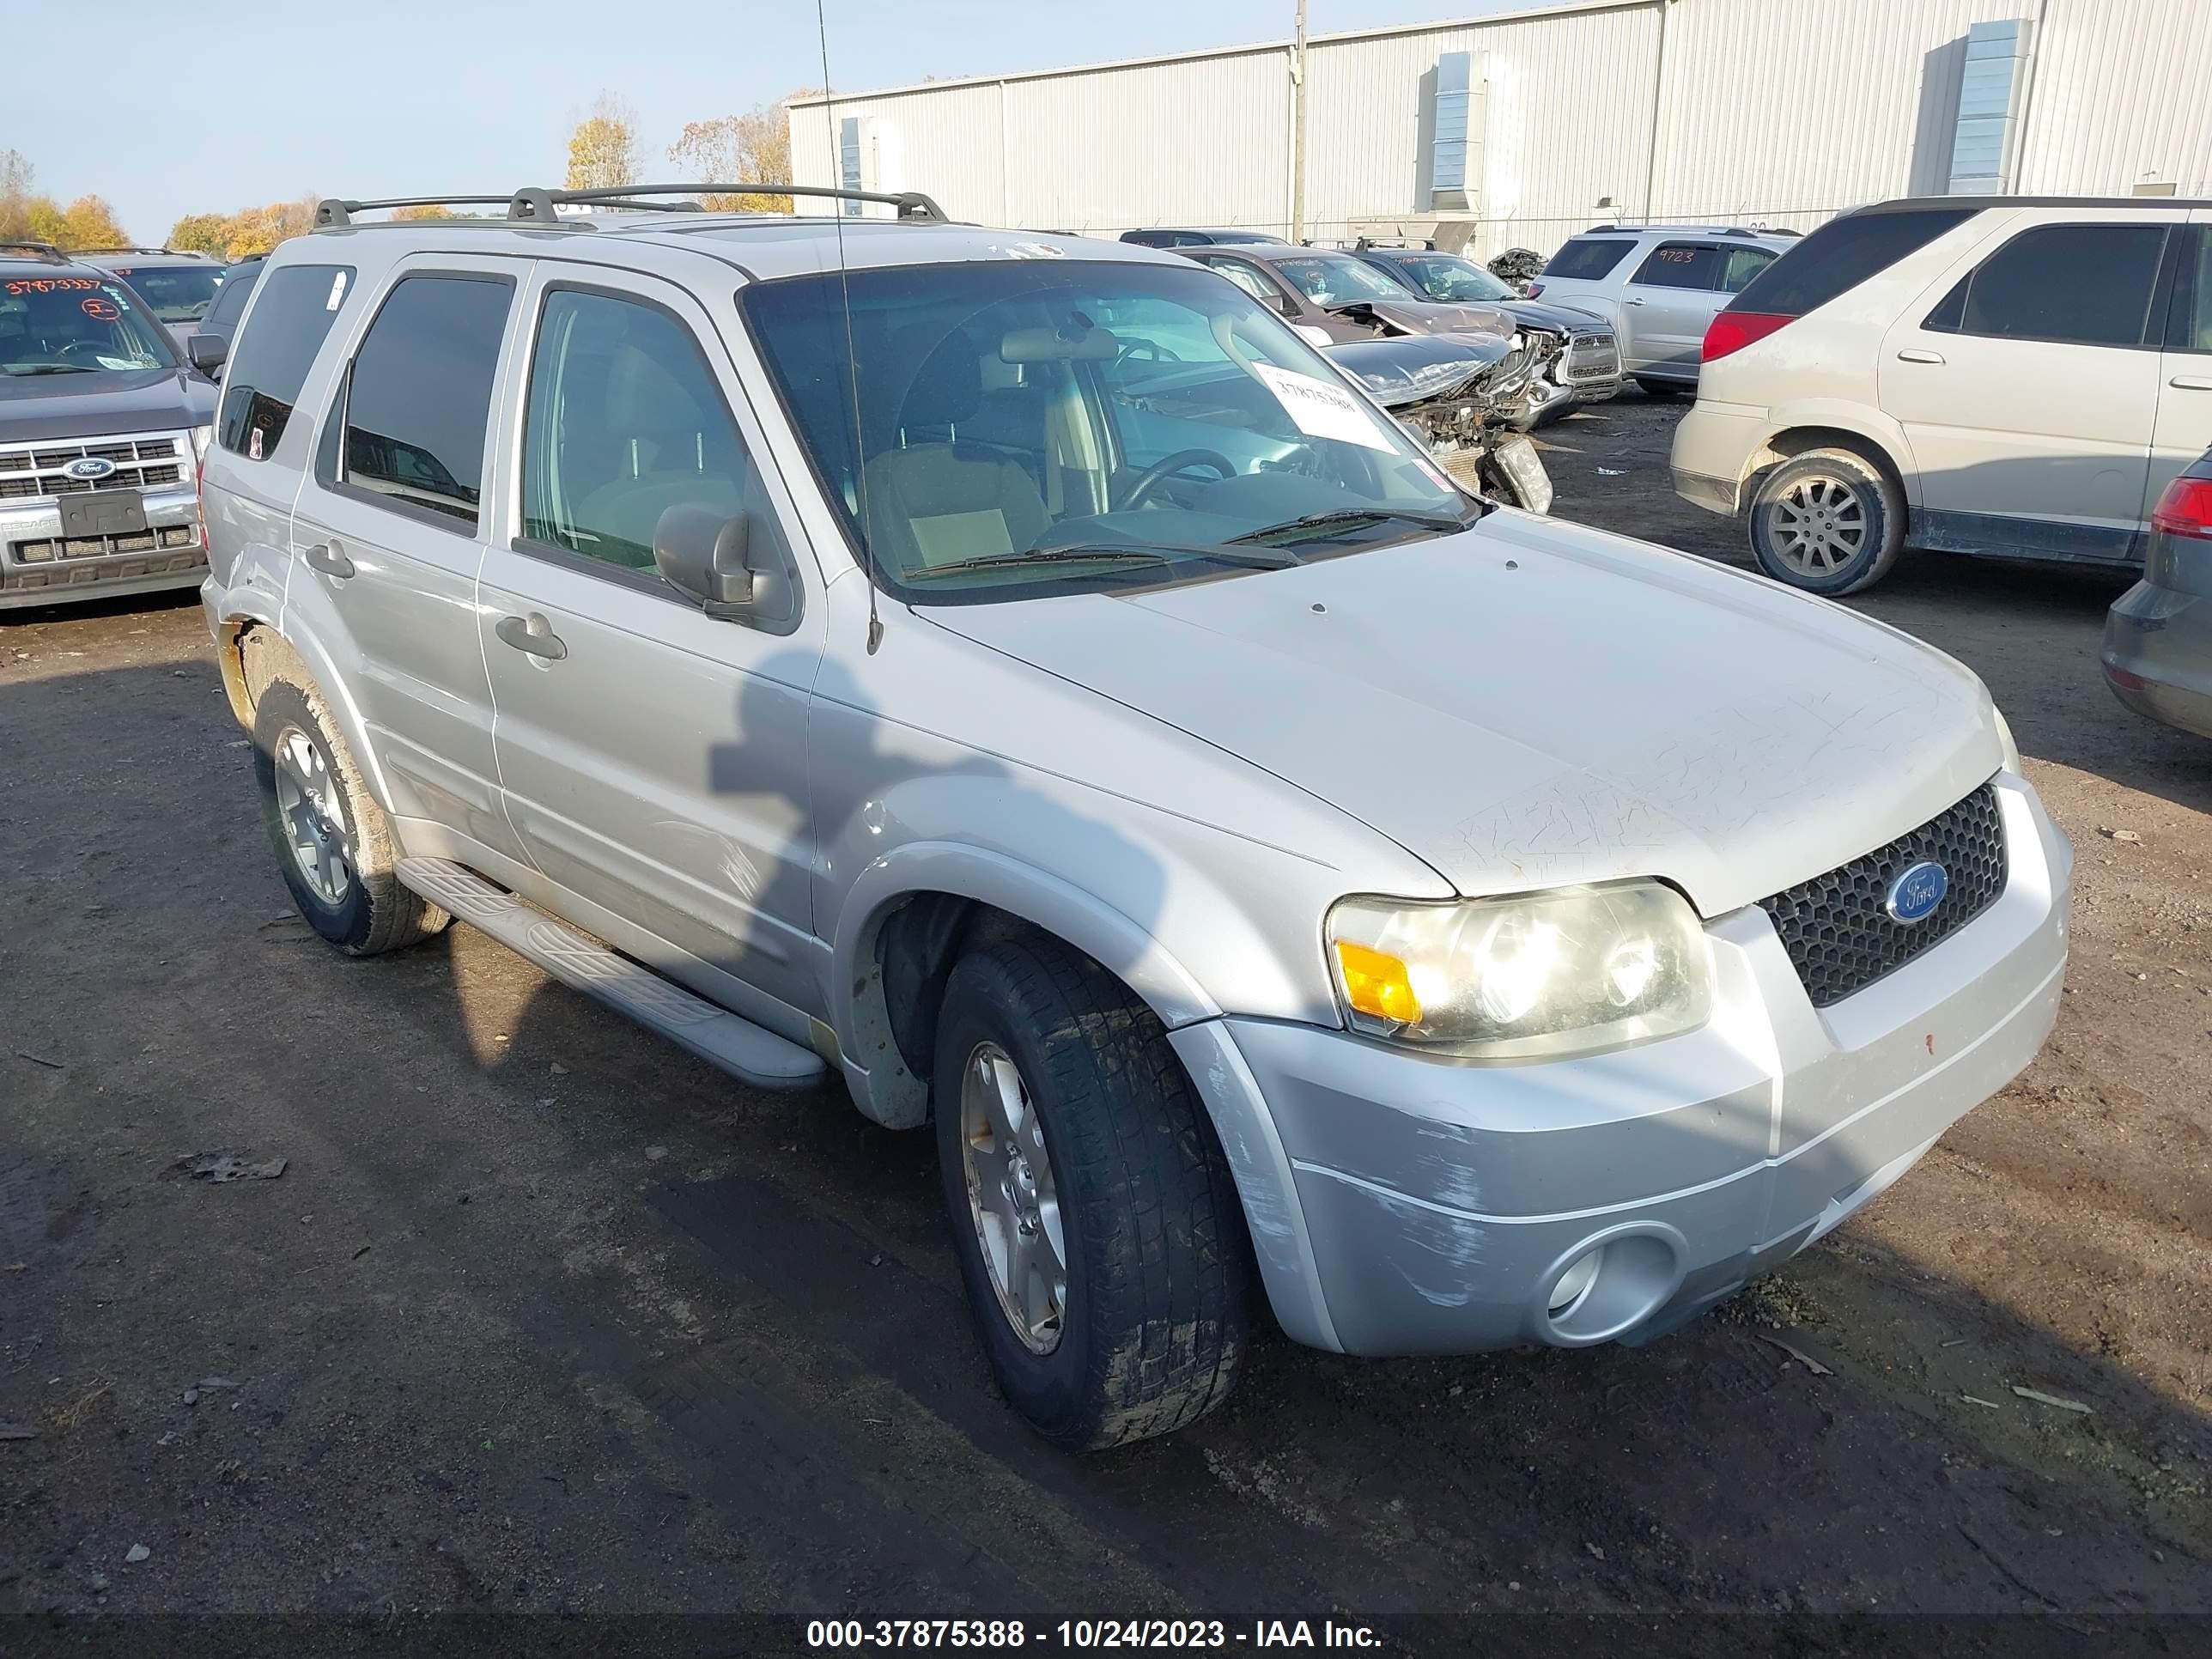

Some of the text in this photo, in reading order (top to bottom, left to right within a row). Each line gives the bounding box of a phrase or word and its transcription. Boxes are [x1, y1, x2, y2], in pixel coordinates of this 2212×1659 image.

[1659, 249, 1696, 264] 9723
[4, 279, 101, 295] 37873337
[1275, 380, 1356, 413] 37875388
[78, 463, 103, 474] Ford
[1, 520, 60, 532] ESCAPE
[1905, 870, 1939, 910] Ford
